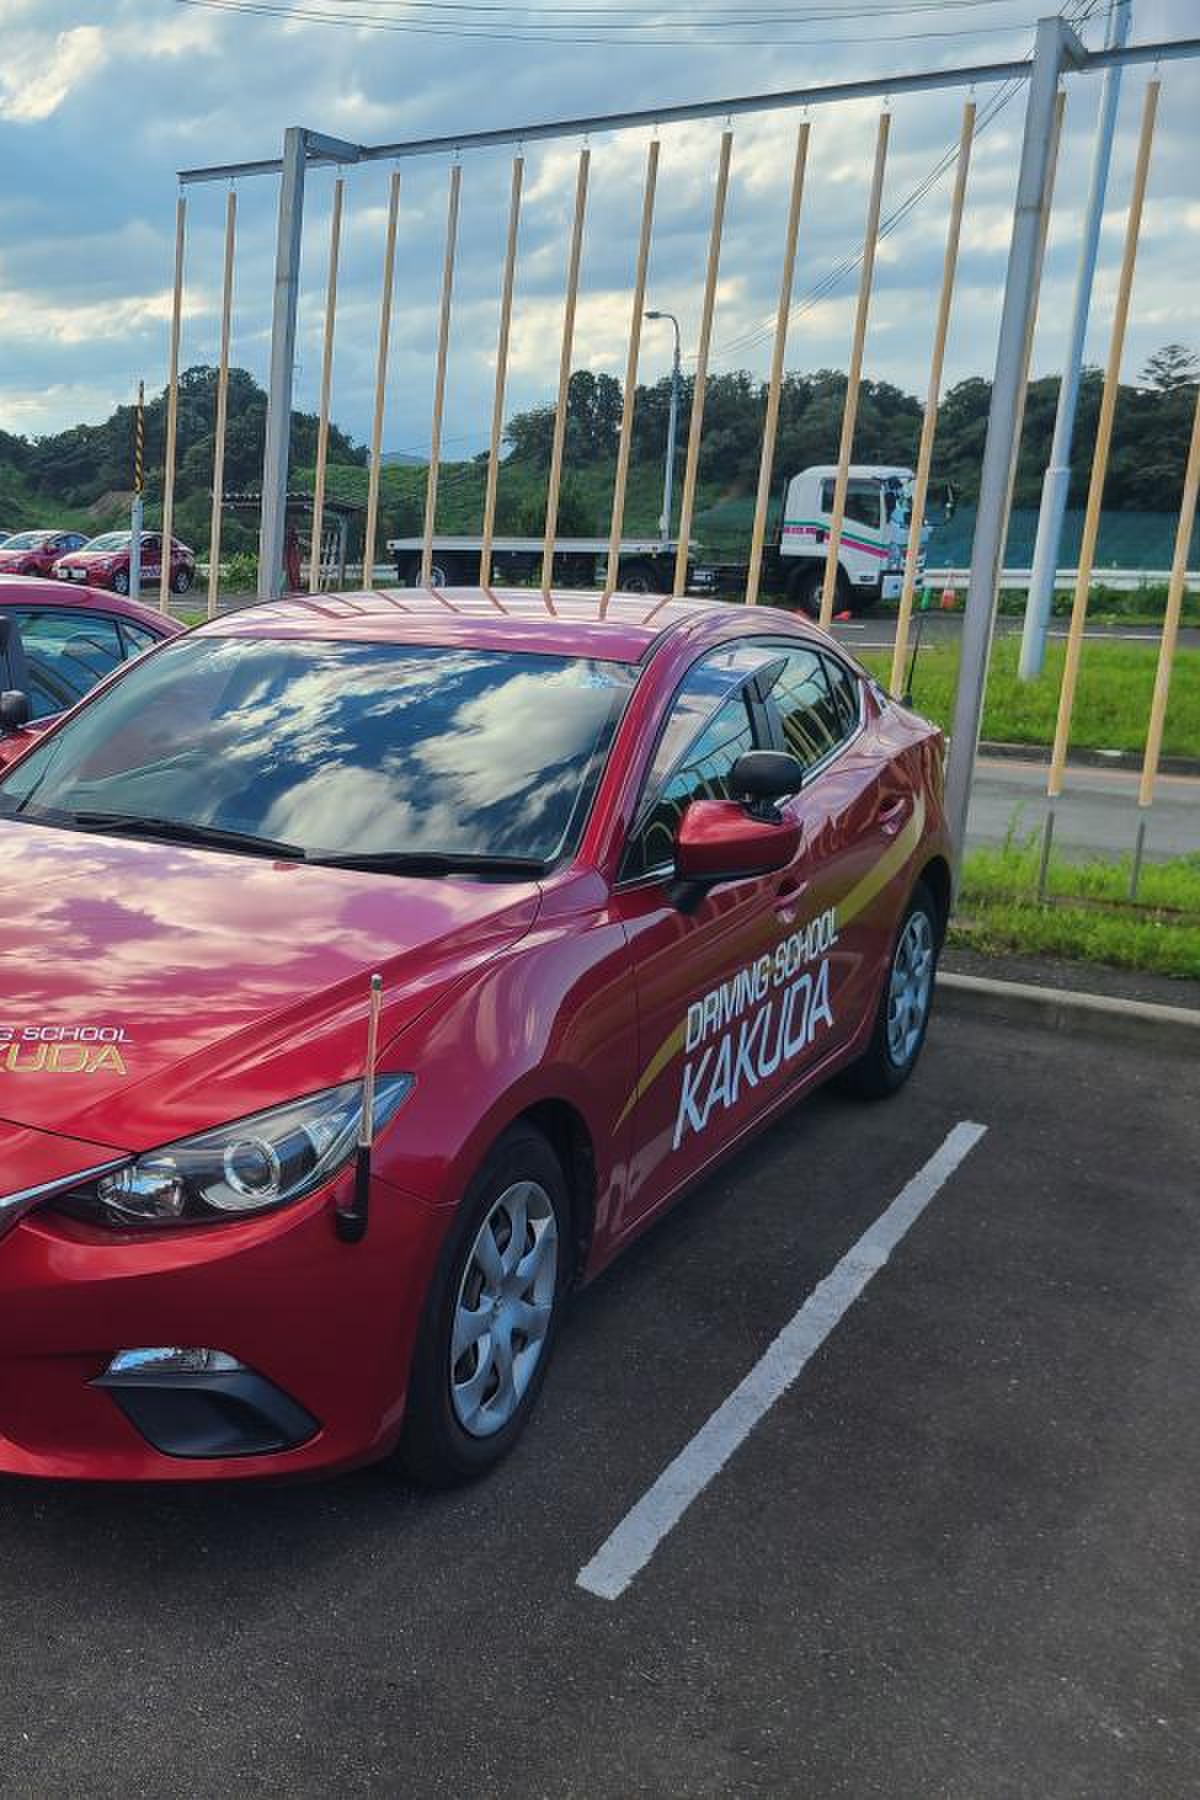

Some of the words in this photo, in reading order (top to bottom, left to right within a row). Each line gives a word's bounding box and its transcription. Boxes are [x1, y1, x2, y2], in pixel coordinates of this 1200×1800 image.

[21, 1026, 133, 1042] SCHOOL
[686, 954, 770, 1054] DRIVING
[773, 907, 839, 987] SCHOOL
[672, 959, 834, 1151] KAKUDA
